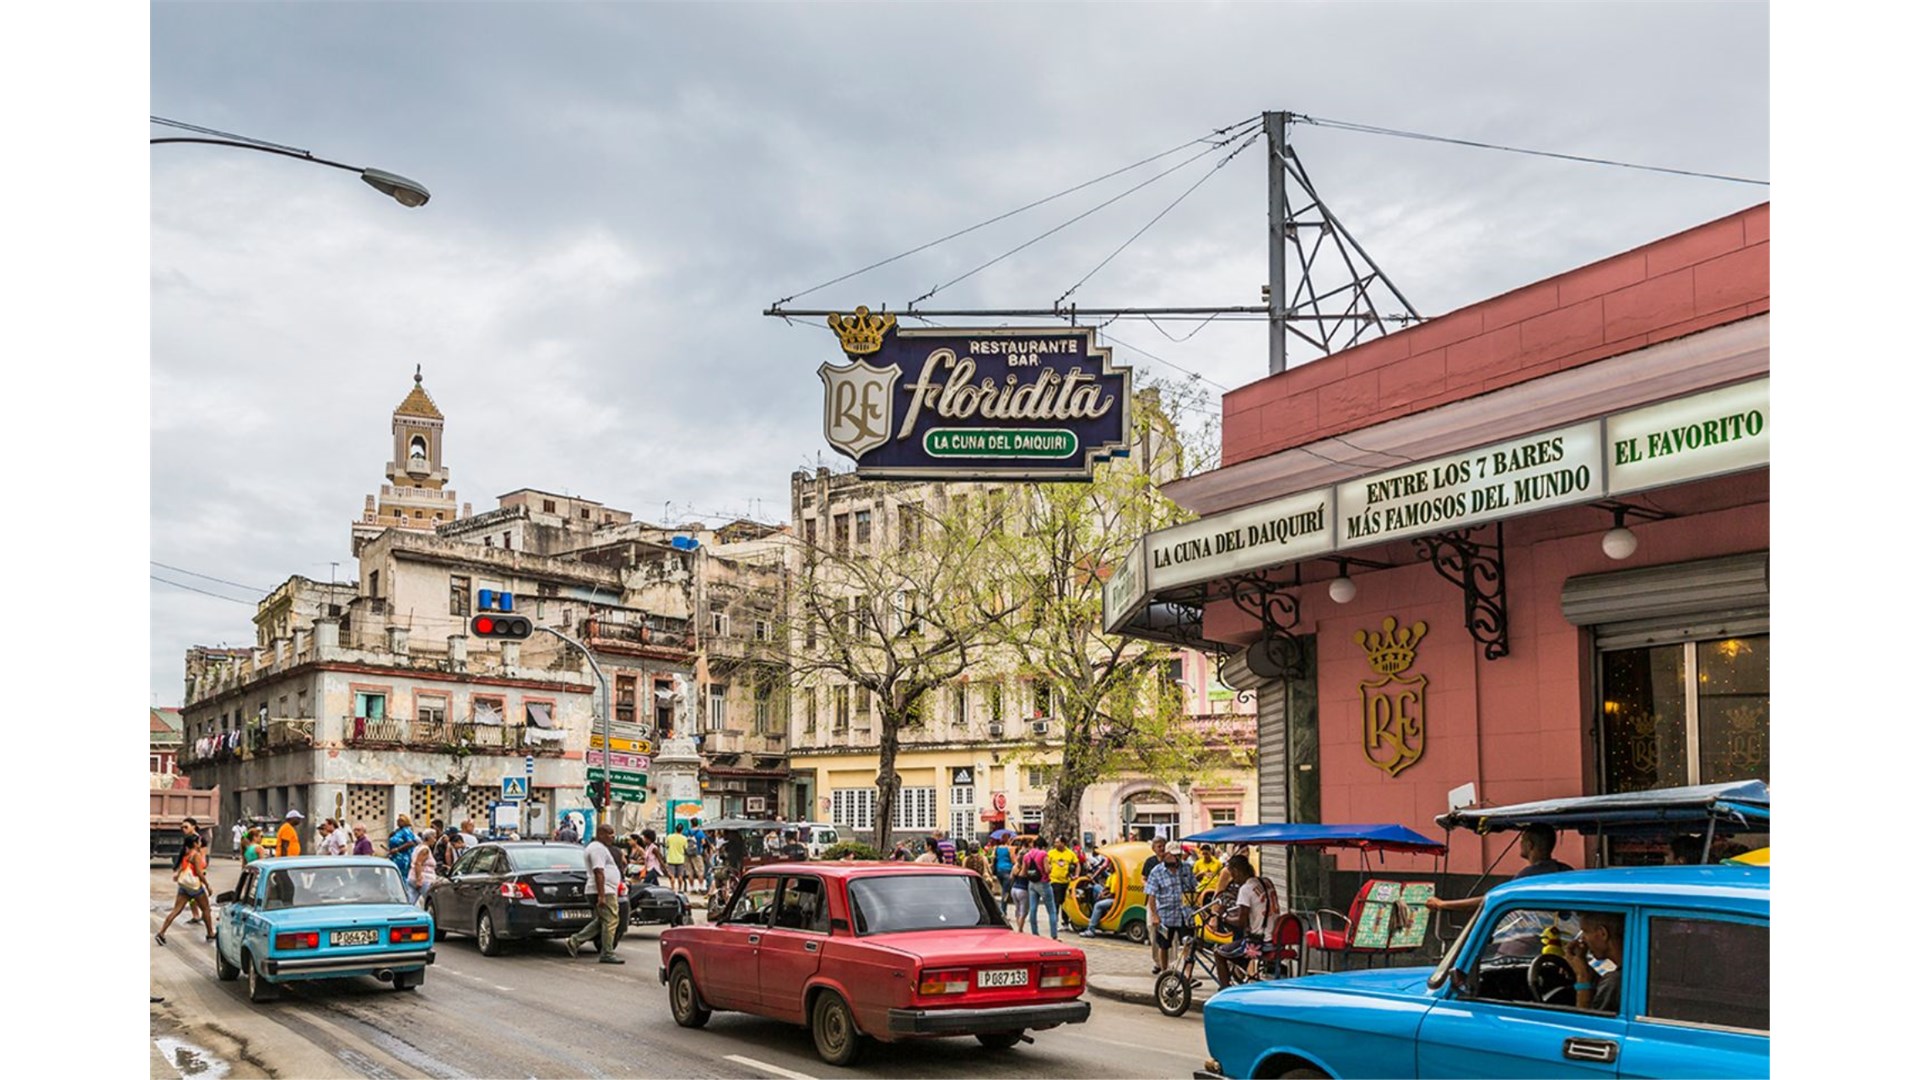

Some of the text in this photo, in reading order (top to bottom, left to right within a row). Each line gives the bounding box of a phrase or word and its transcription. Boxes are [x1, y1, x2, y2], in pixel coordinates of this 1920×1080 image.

[970, 339, 1077, 354] RESTAURANTE
[1008, 354, 1039, 367] BAR
[934, 434, 1067, 451] LA CUNA DEL DAIQUIRI
[1614, 410, 1764, 466] EL FAVORITO
[1366, 437, 1564, 504] ENTRE LOS 7 BARES
[1347, 464, 1590, 539] MÁS FAMOSOS DEL MUNDO
[1154, 502, 1325, 569] LA CUNA DEL DAIQUIRÍ
